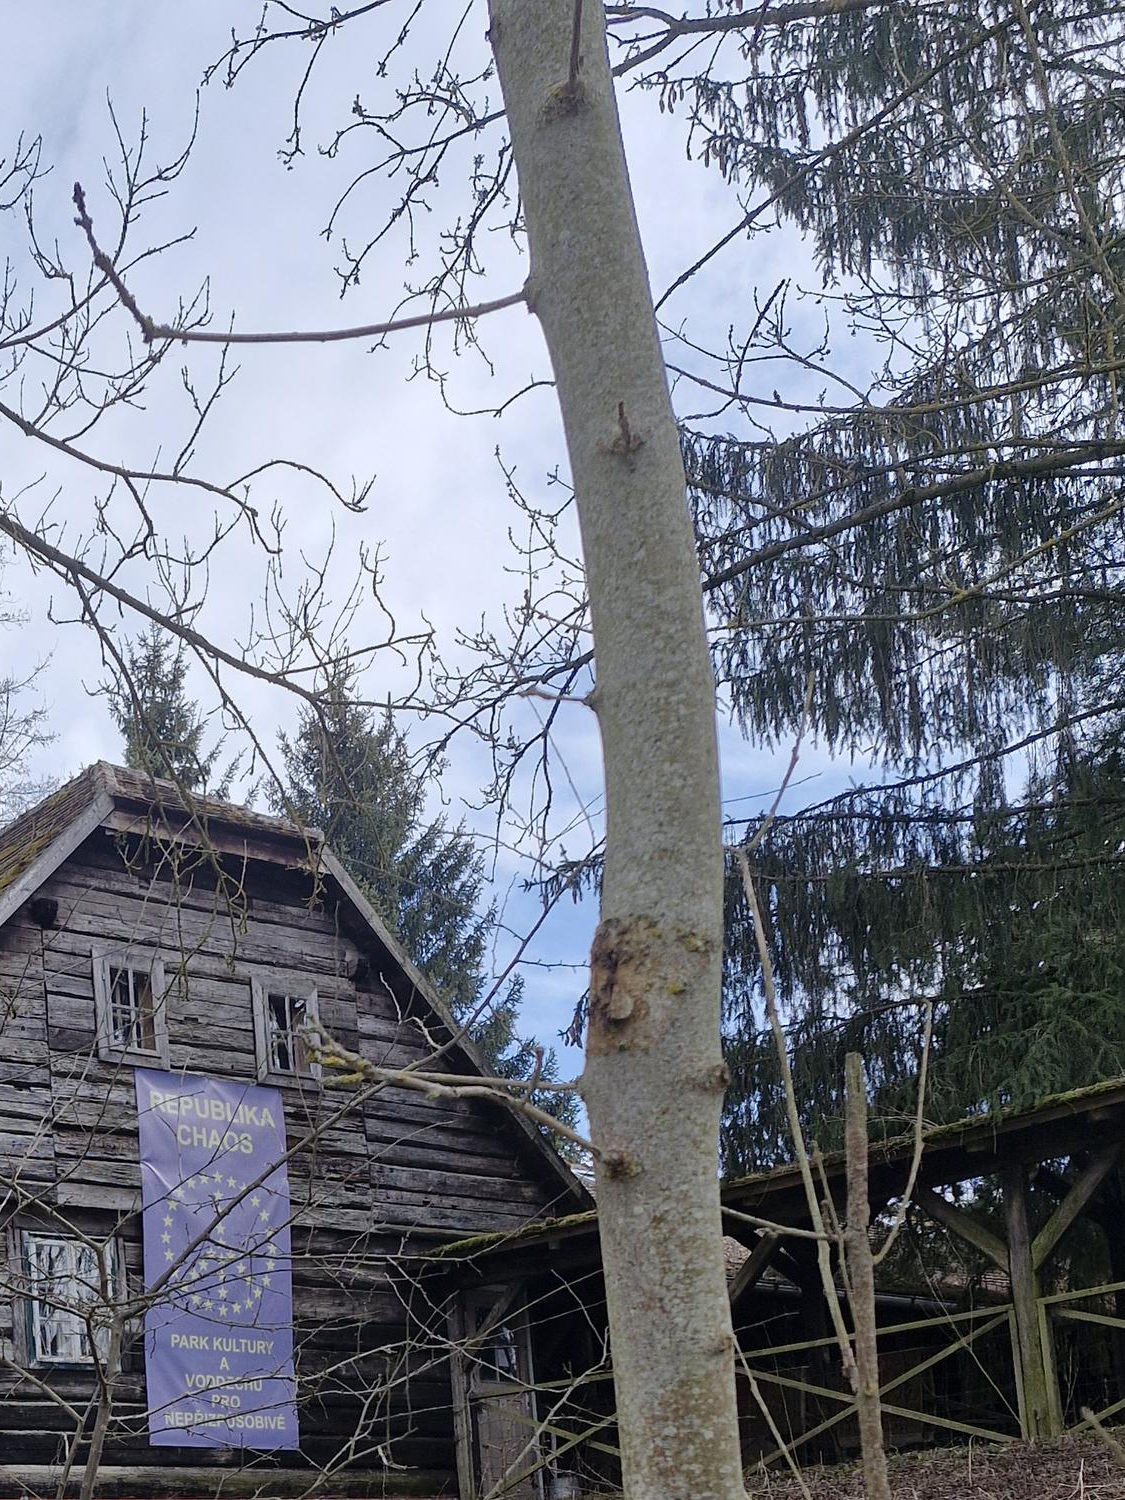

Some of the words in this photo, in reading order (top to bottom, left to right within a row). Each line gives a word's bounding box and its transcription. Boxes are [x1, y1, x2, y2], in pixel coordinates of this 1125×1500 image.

[149, 1090, 275, 1128] REPUBLIKA
[177, 1124, 253, 1154] CHAOS
[170, 1334, 209, 1350] PARK
[213, 1337, 274, 1355] KULTURY
[219, 1357, 230, 1371] A
[211, 1394, 241, 1408] PRO
